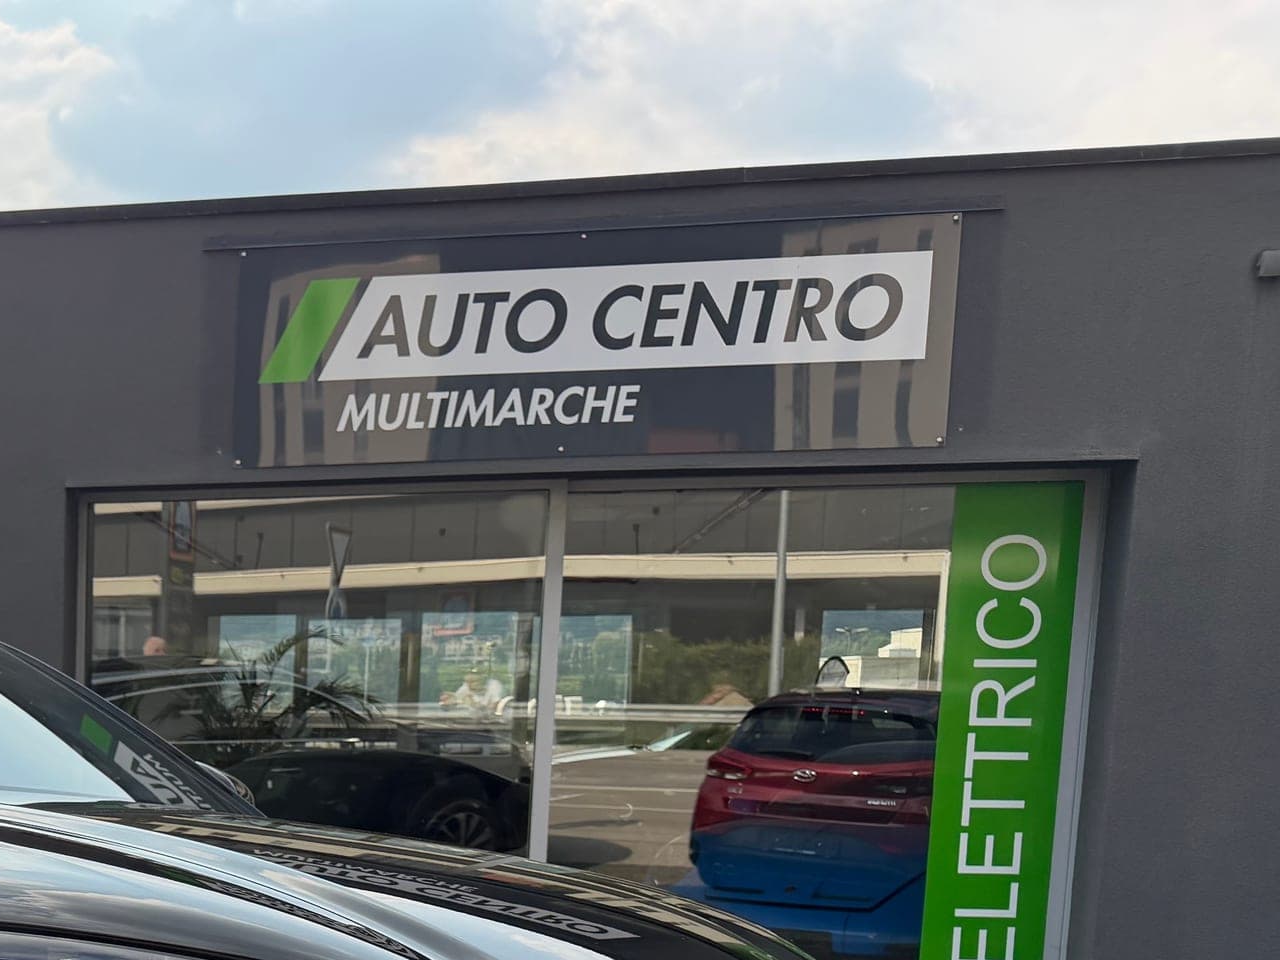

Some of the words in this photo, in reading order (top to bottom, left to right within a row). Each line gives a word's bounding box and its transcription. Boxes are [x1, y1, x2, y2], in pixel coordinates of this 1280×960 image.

[357, 287, 568, 359] AUTO
[592, 272, 904, 350] CENTRO
[336, 384, 641, 432] MULTIMARCHE
